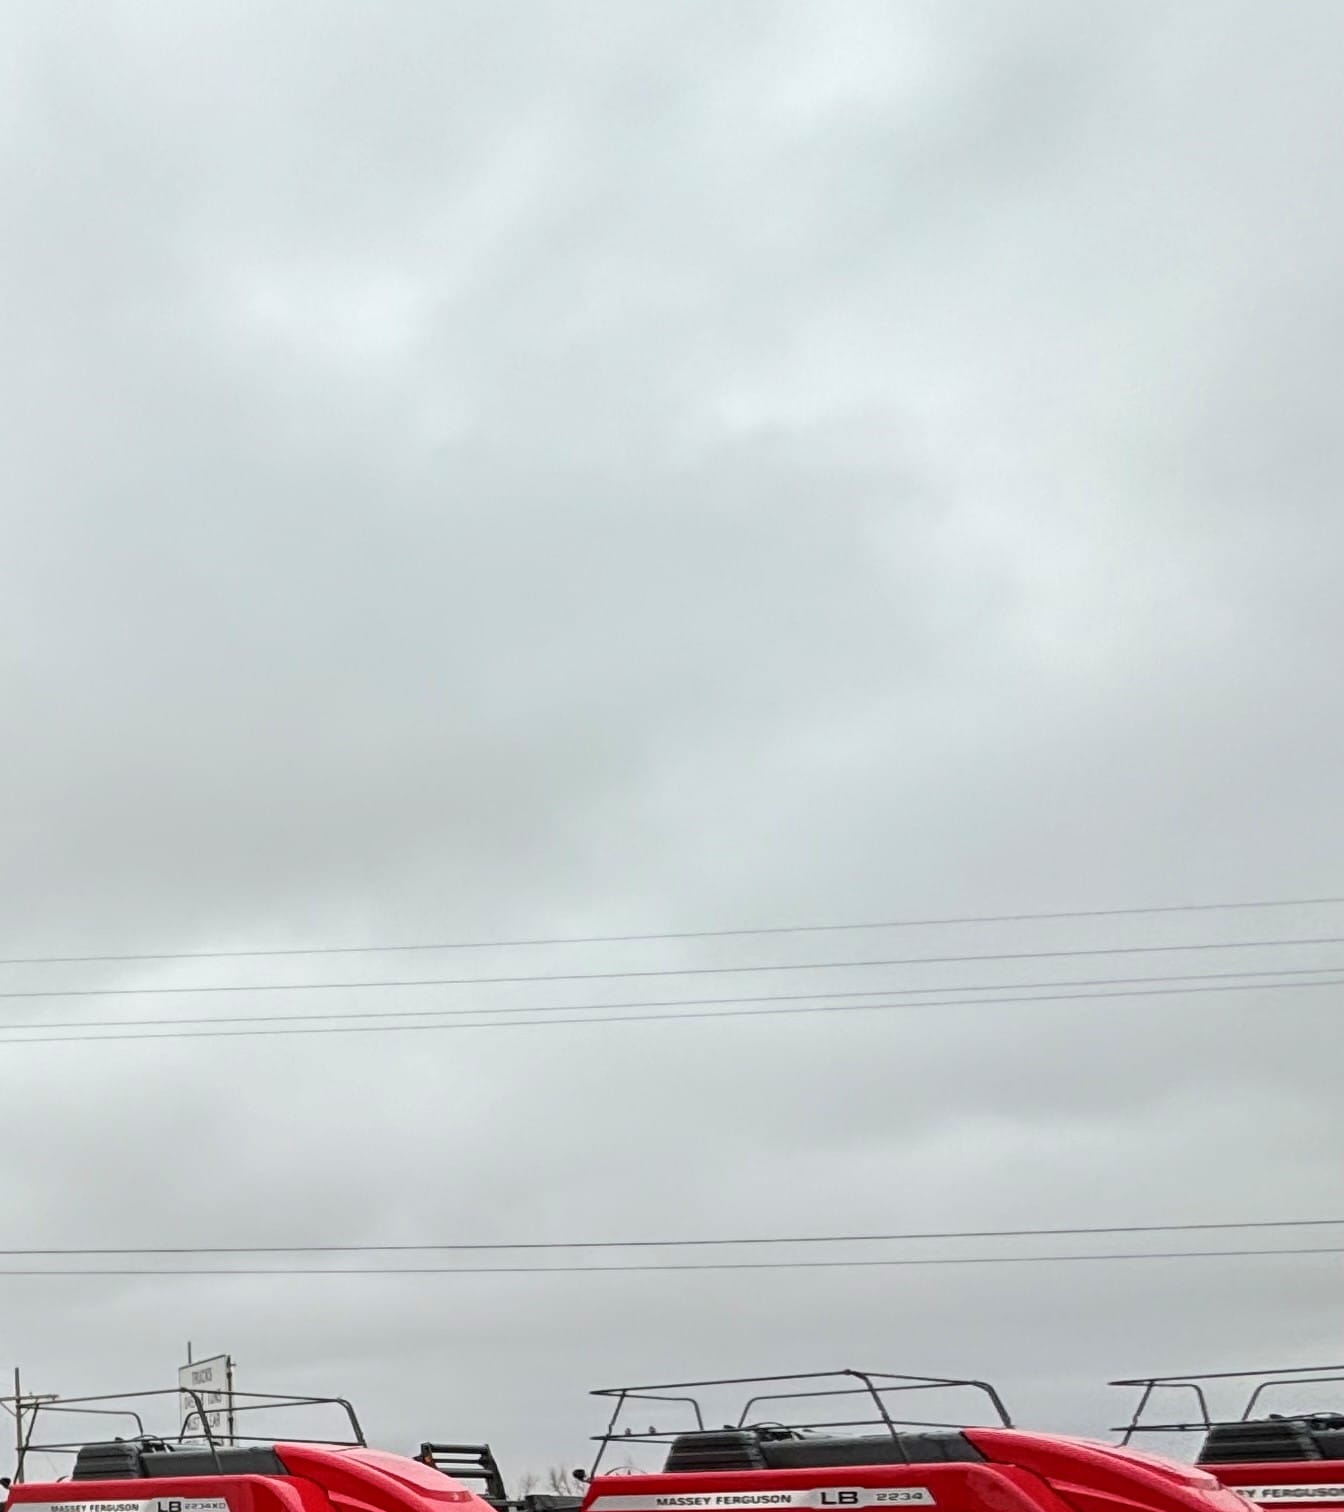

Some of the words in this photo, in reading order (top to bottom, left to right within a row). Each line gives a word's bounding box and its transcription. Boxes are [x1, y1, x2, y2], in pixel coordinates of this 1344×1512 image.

[656, 1496, 712, 1507] MASSEY
[715, 1494, 792, 1506] FERGUSON
[820, 1491, 859, 1505] LB
[875, 1492, 924, 1502] 2234
[50, 1504, 87, 1512] MASSEY
[89, 1503, 140, 1512] FERGUSON
